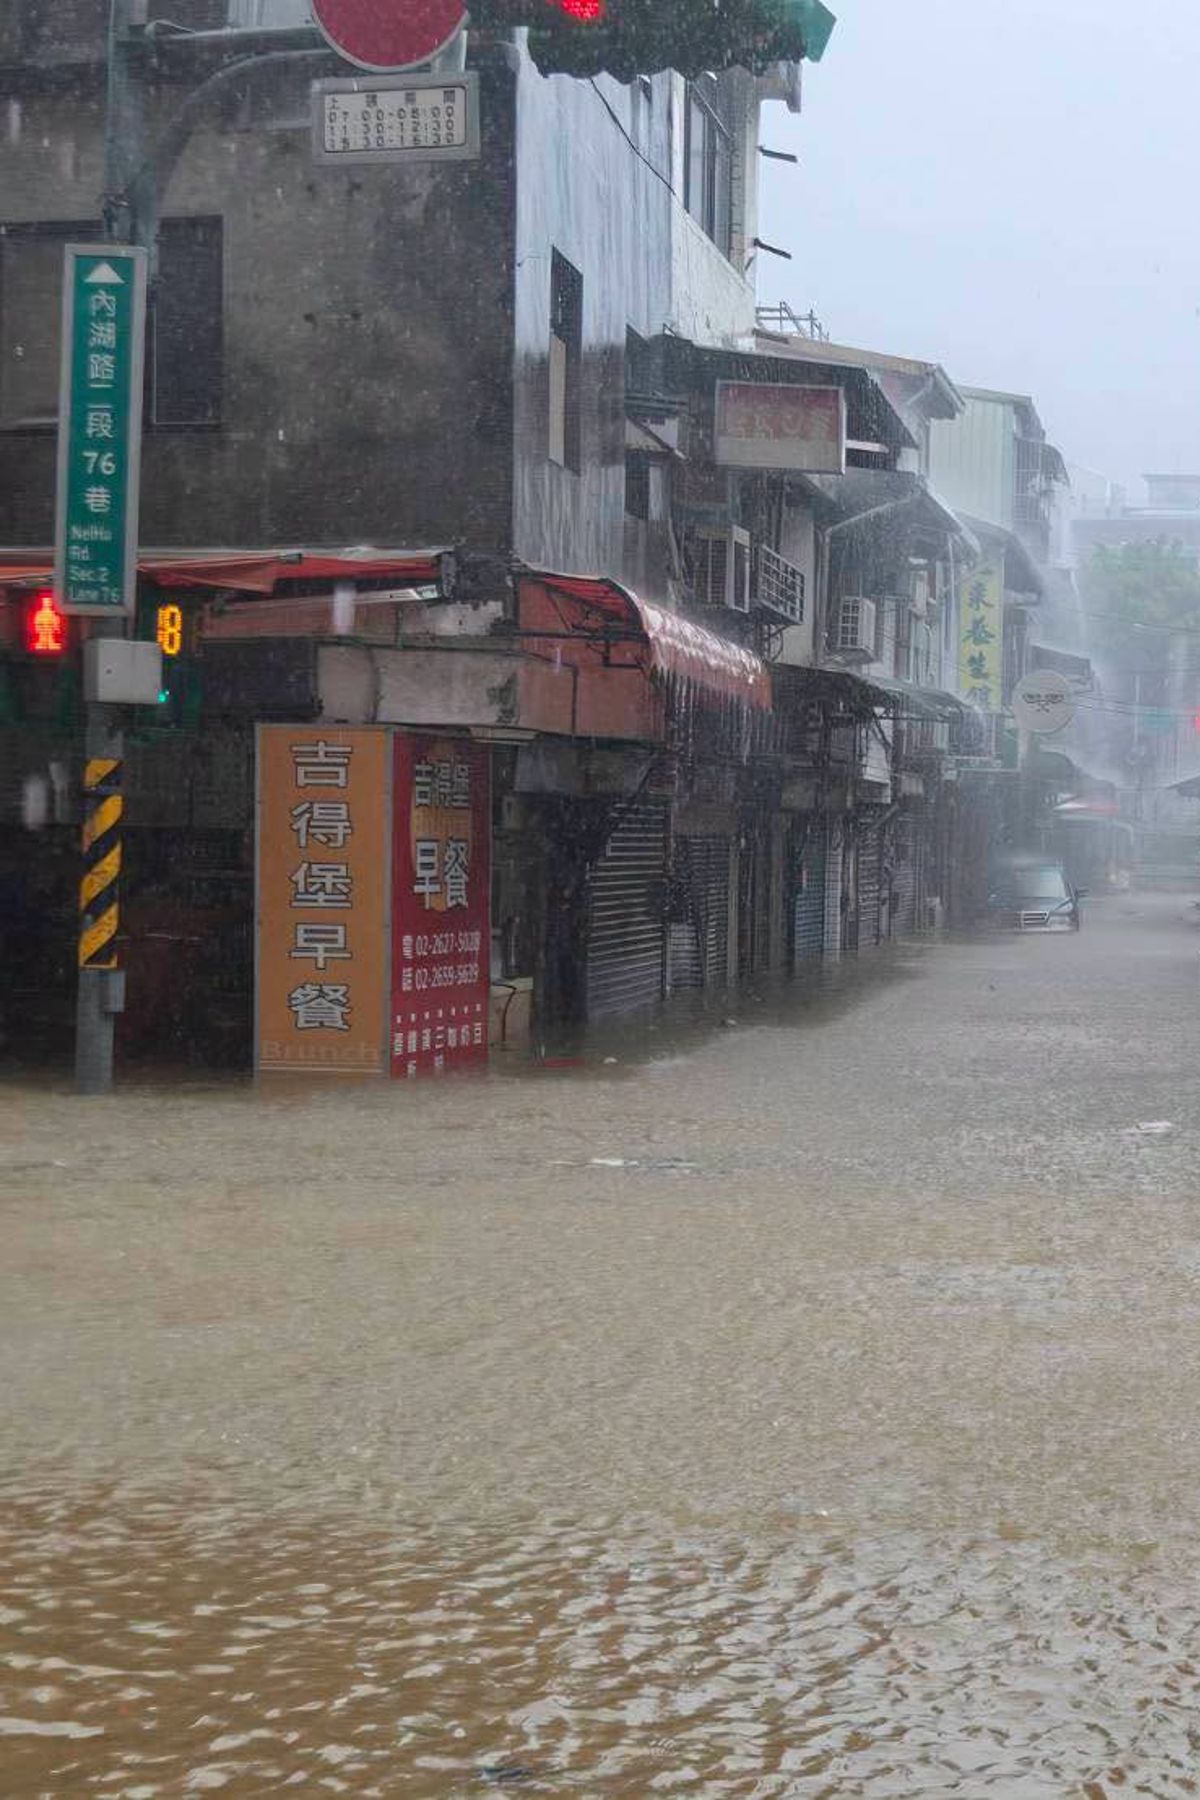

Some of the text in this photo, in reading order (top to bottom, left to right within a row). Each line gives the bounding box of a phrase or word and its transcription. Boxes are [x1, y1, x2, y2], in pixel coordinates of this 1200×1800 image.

[288, 739, 353, 1032] 吉得堡早餐
[413, 839, 470, 910] 早餐
